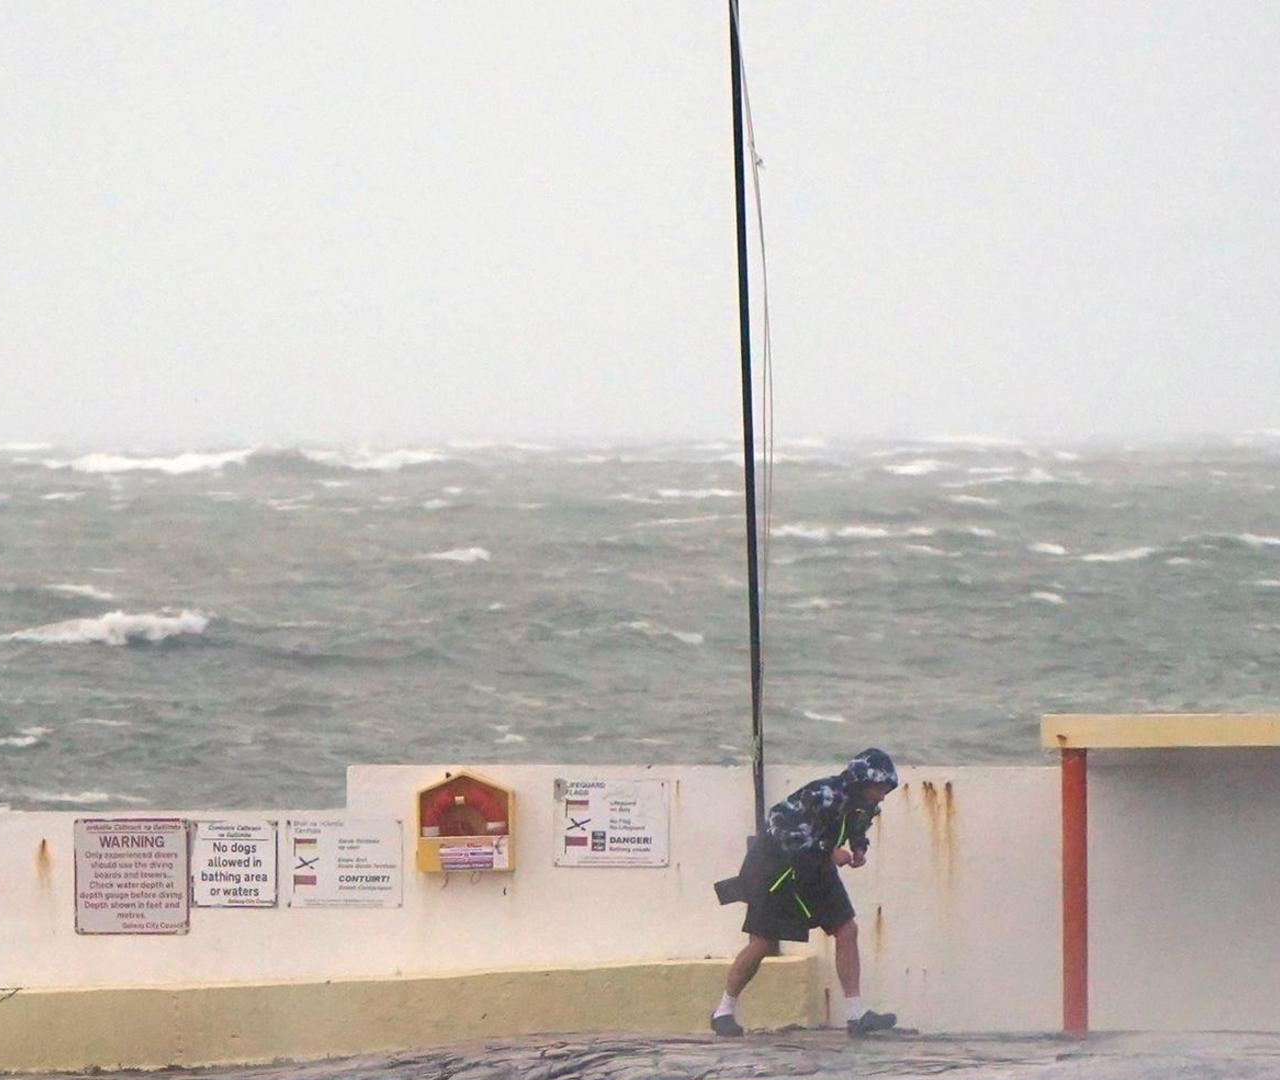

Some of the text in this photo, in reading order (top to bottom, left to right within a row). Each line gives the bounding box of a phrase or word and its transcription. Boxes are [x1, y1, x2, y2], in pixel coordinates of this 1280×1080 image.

[99, 835, 165, 848] WARNING
[609, 836, 652, 844] DANGER!
[213, 842, 257, 855] No dogs
[84, 851, 178, 860] Only experienced divers
[149, 861, 174, 870] diving
[208, 856, 262, 867] allowed in
[201, 871, 268, 884] bathing area
[89, 881, 174, 890] Check water depth at
[80, 891, 103, 899] depth
[105, 892, 129, 900] gauge
[130, 891, 156, 899] before
[210, 886, 259, 896] or waters
[84, 901, 180, 909] Depth shown in feet and
